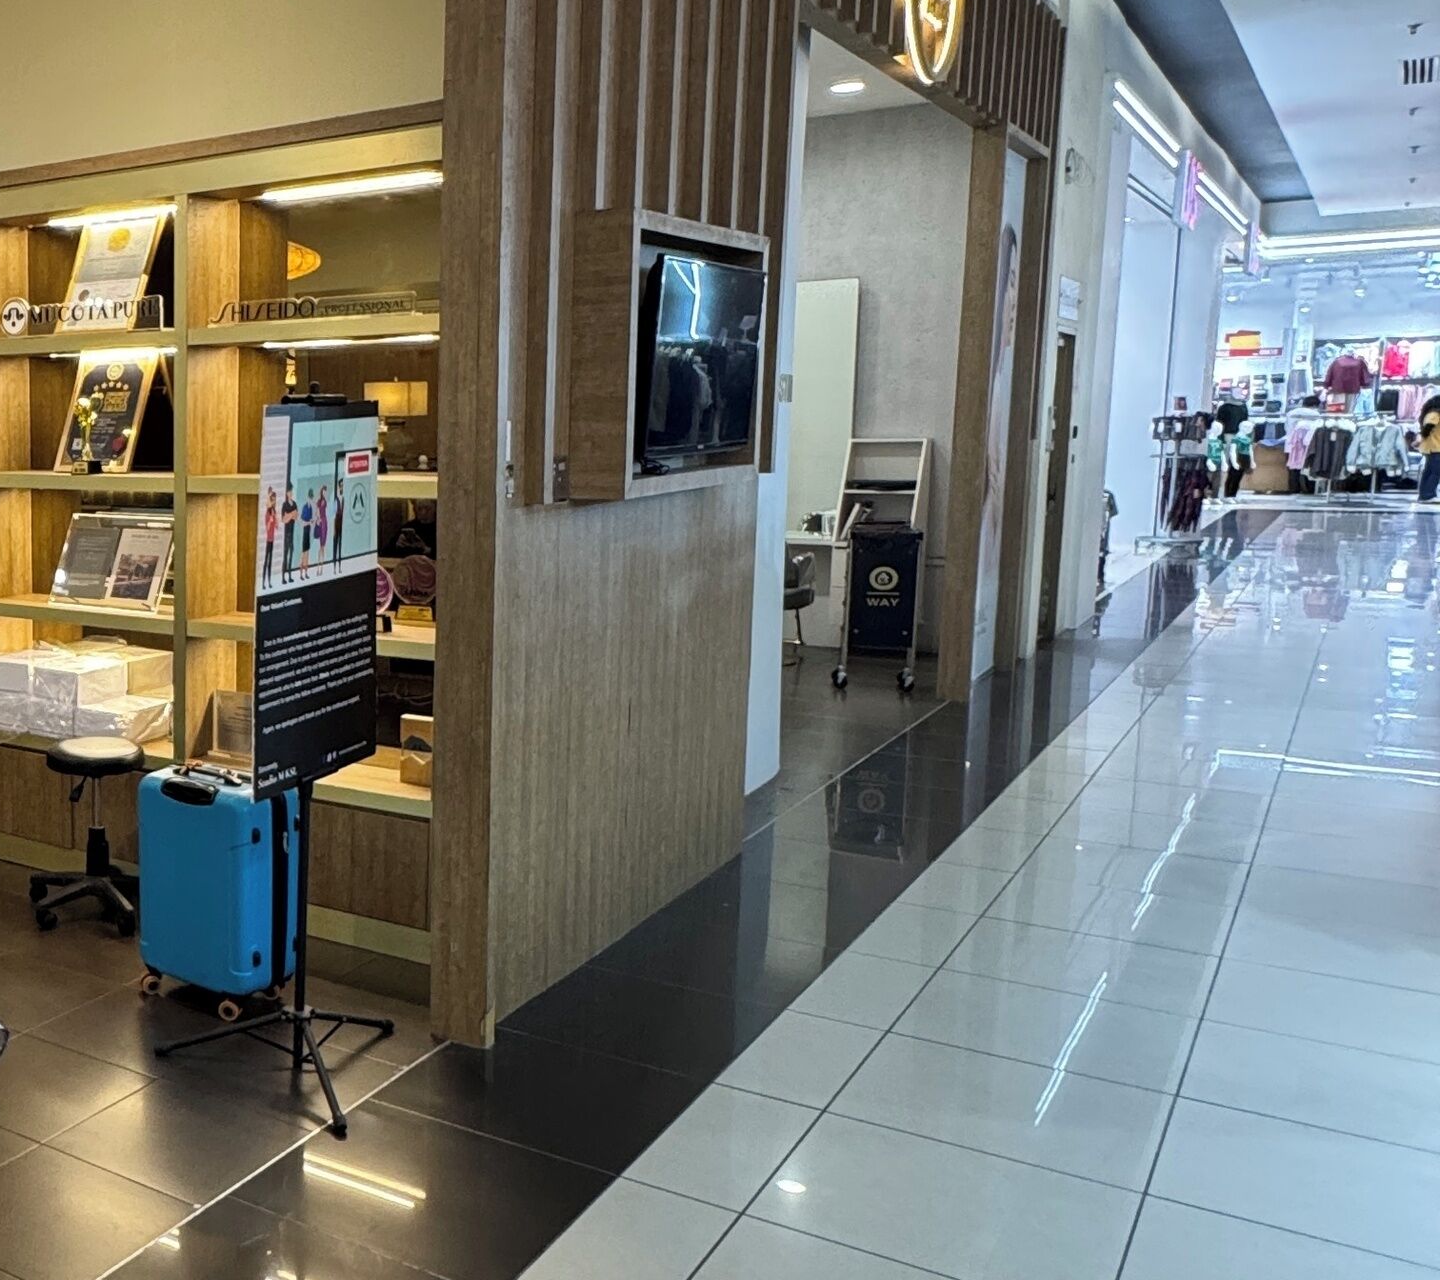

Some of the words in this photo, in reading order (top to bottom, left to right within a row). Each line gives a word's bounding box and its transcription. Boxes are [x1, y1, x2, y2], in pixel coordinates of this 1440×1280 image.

[29, 302, 109, 325] MUCOTA
[113, 297, 160, 319] PURE
[211, 299, 315, 323] SHISEIDO
[324, 299, 406, 314] PROFESSIONAL
[866, 597, 900, 607] WAY
